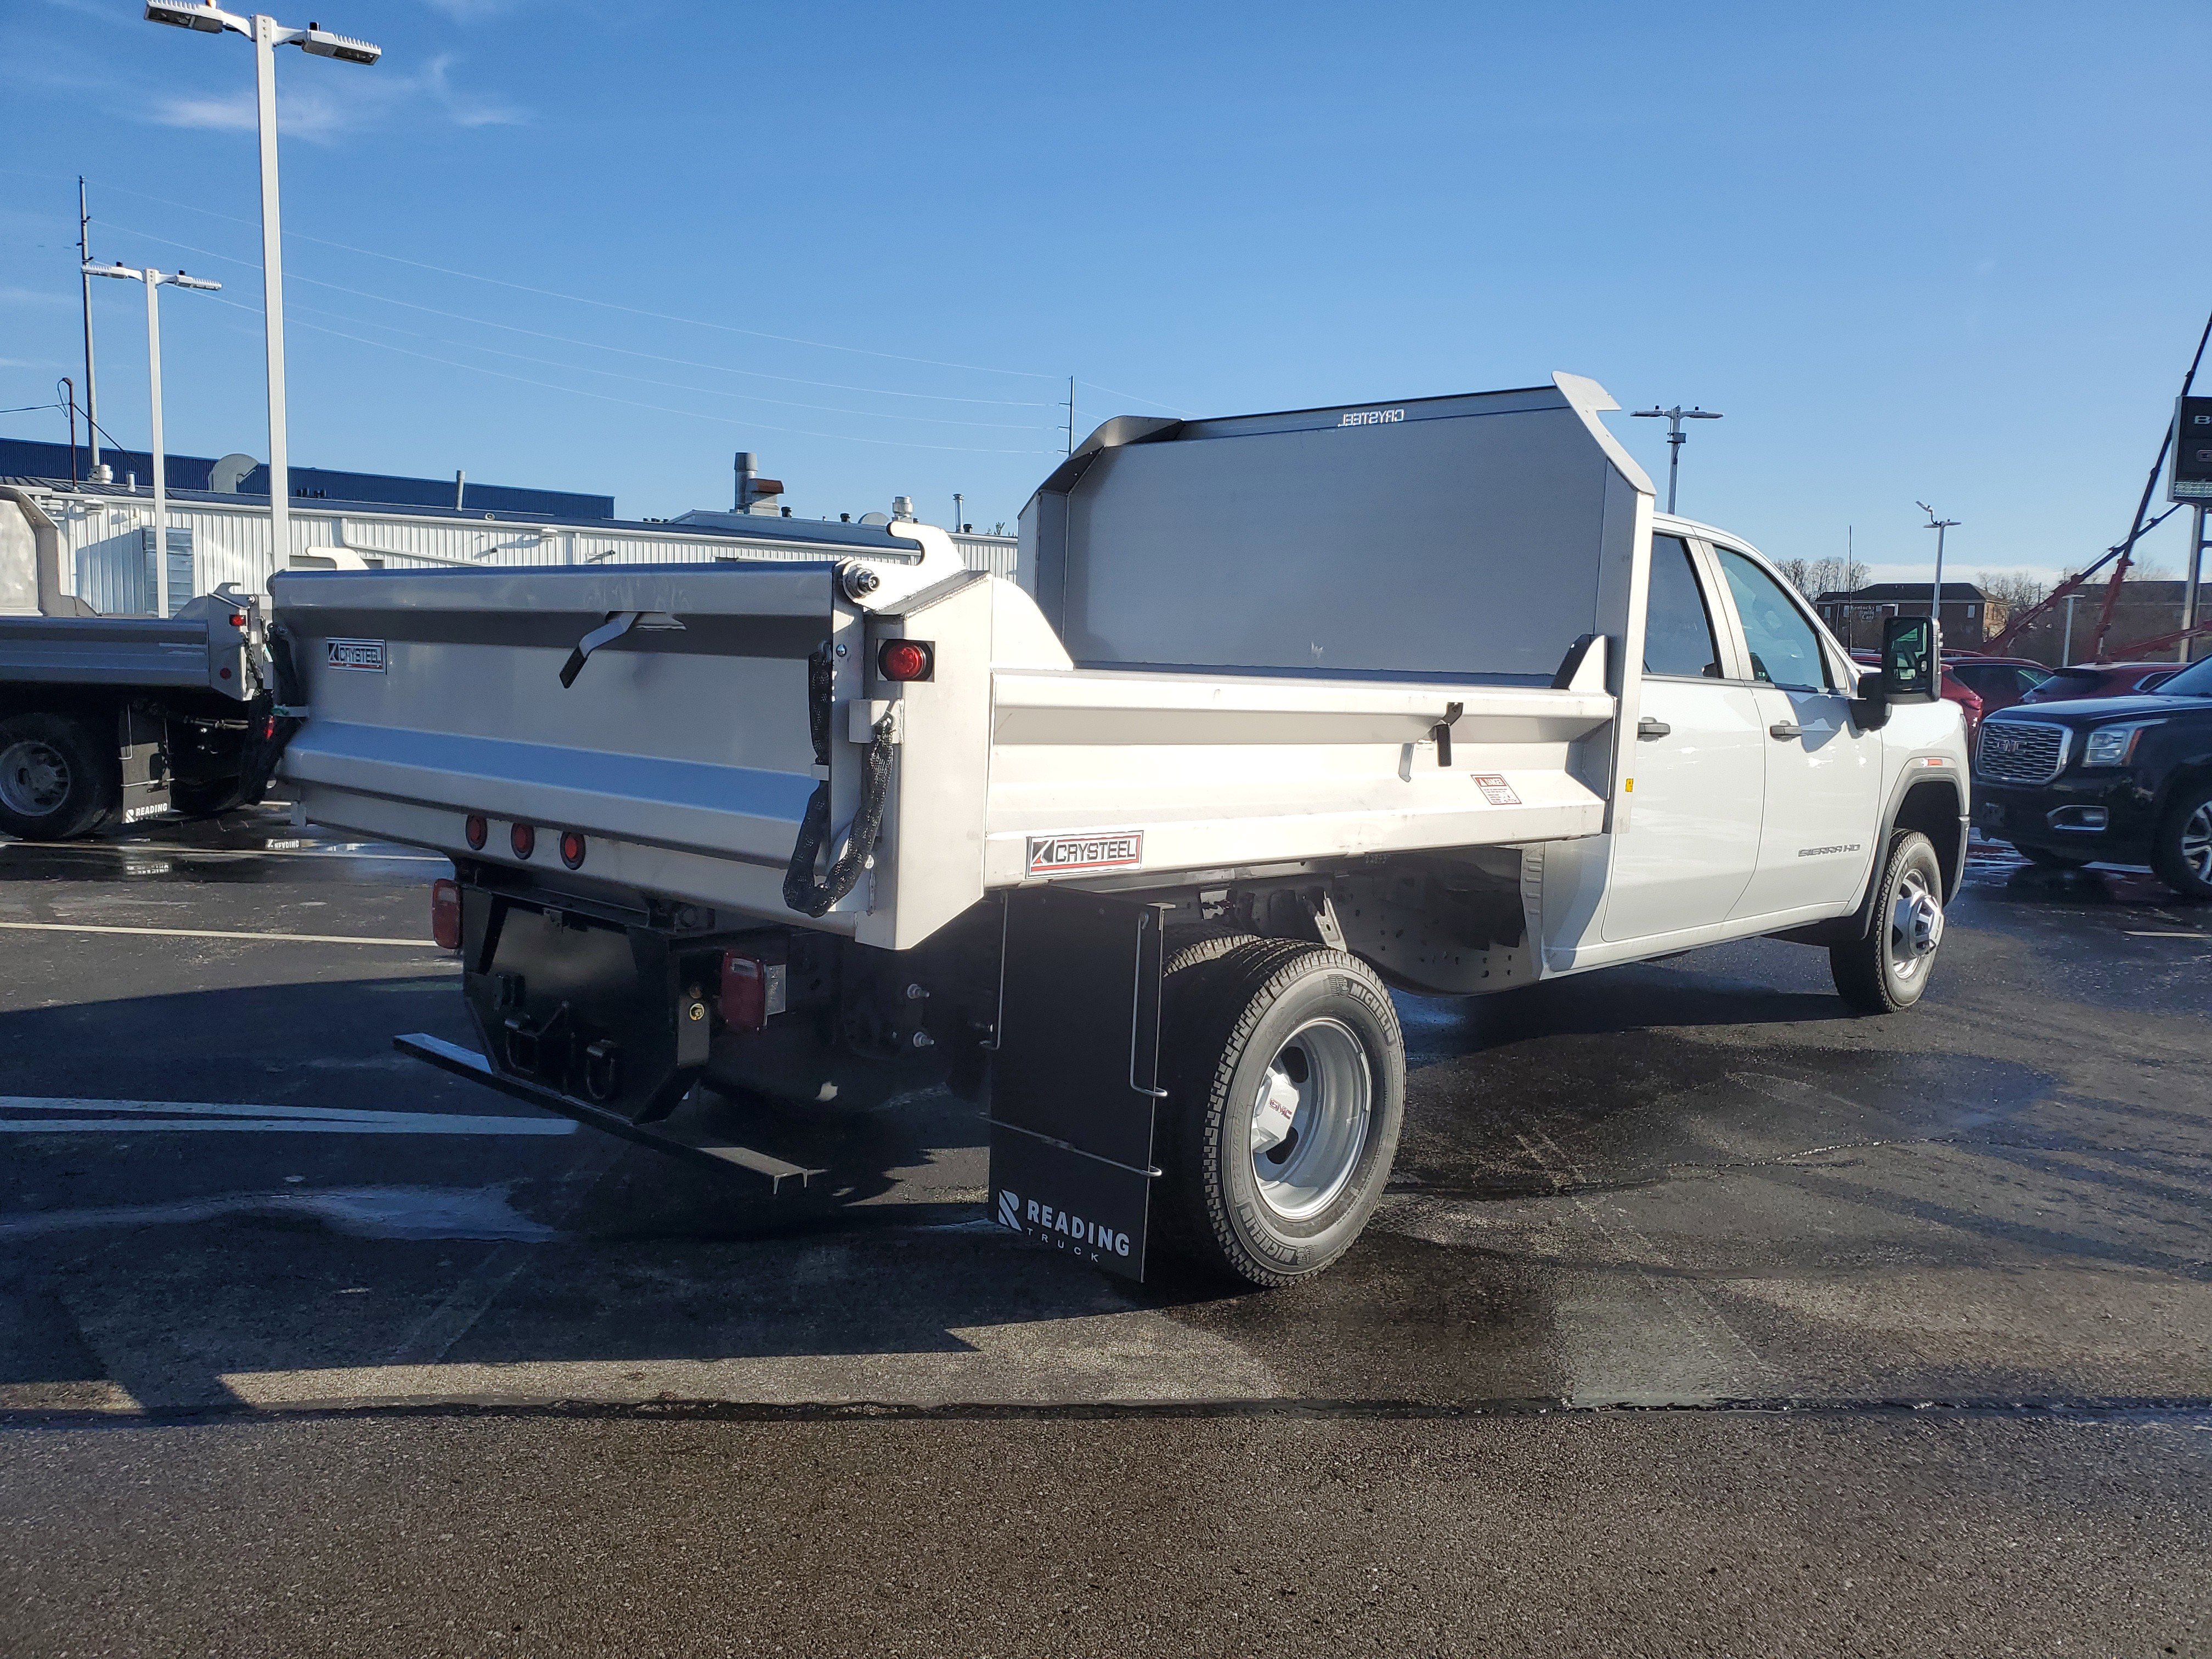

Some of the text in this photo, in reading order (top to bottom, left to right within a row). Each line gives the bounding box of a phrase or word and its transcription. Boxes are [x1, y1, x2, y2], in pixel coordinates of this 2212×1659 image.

[2194, 415, 2212, 424] B
[340, 647, 381, 663] CRYSTEEL
[136, 803, 167, 817] READING
[1056, 840, 1136, 862] CRYSTEEL
[1798, 844, 1860, 857] SIERRA HD
[1350, 983, 1395, 1043] MICHELIN
[1268, 1098, 1292, 1120] GMC
[1027, 1199, 1129, 1256] READING
[1240, 1207, 1295, 1263] MICHELIN
[1027, 1227, 1098, 1262] TRUCK
